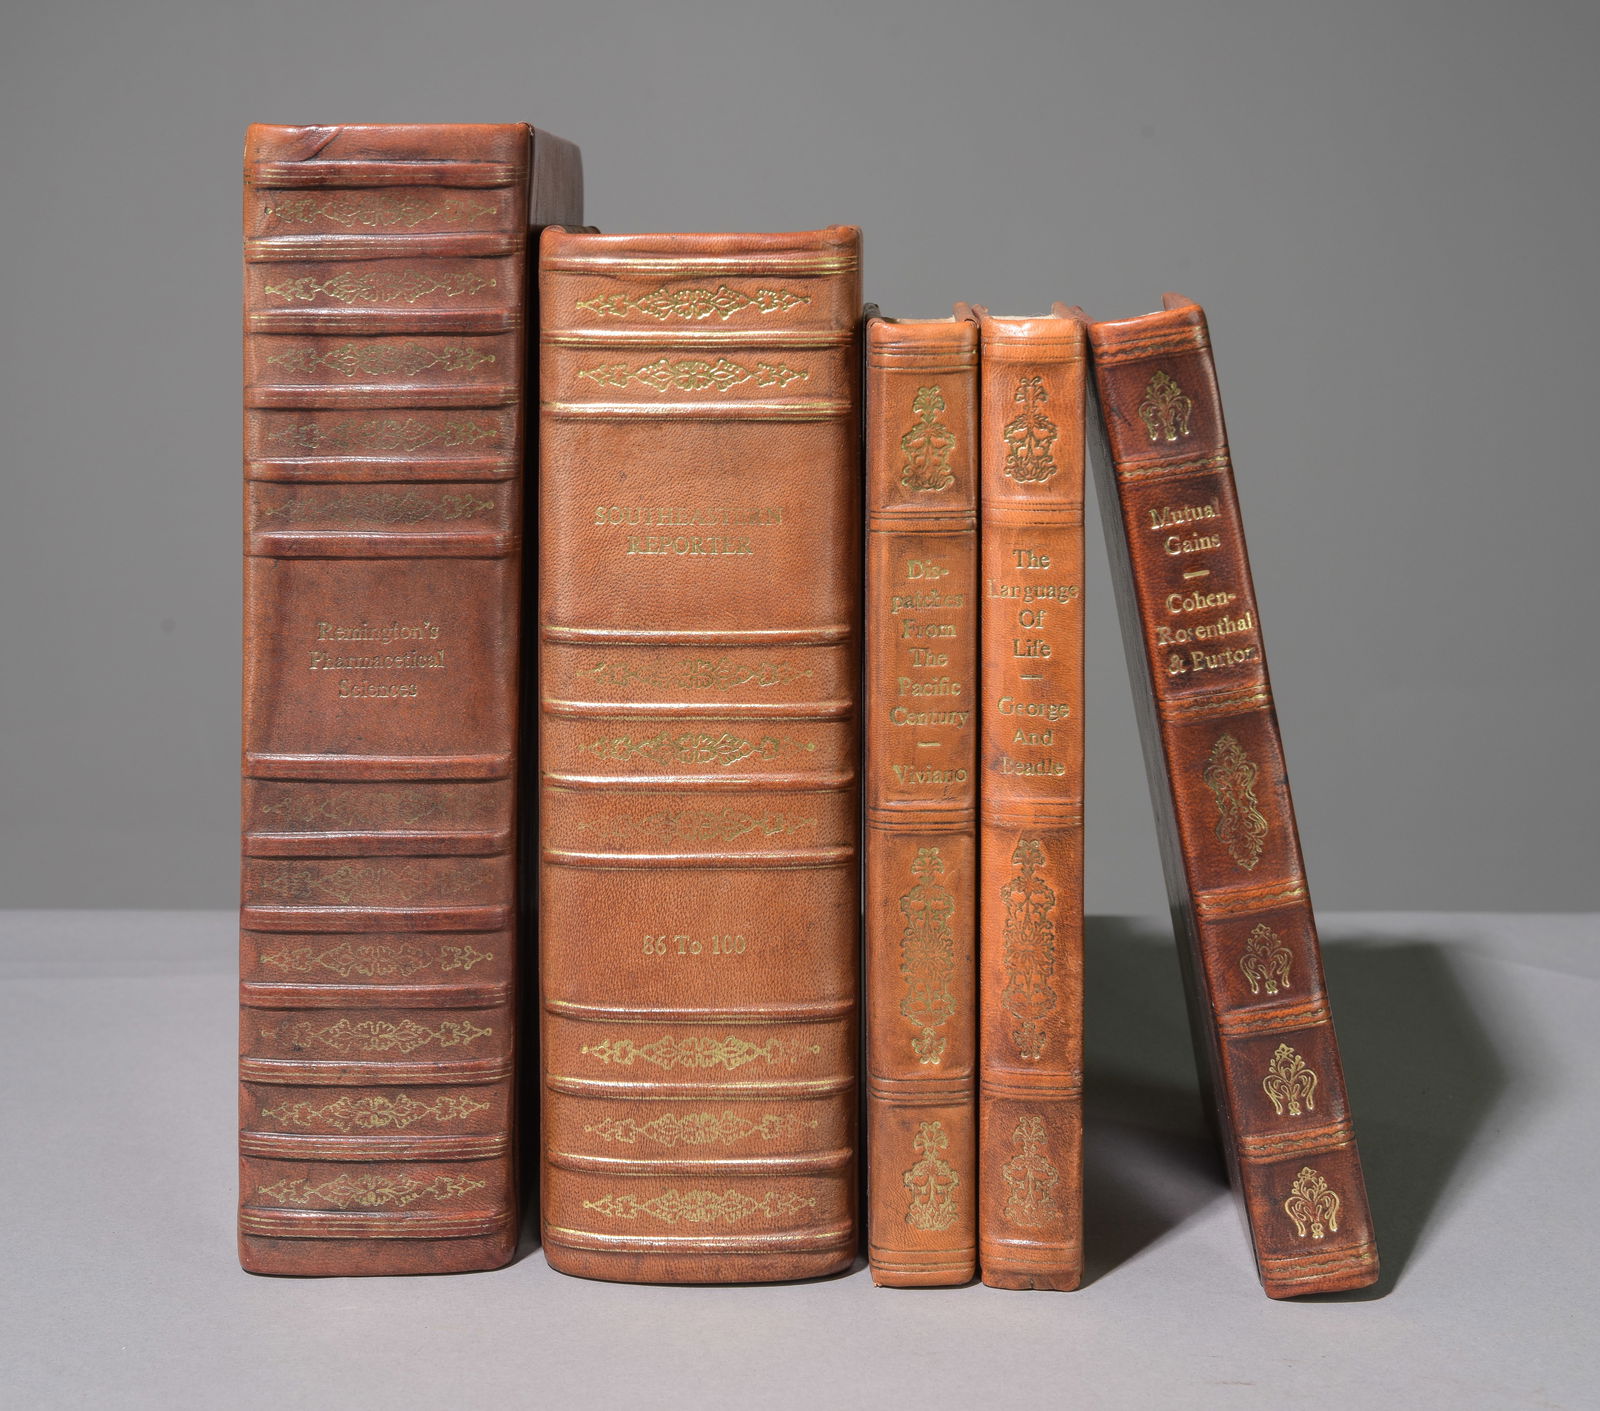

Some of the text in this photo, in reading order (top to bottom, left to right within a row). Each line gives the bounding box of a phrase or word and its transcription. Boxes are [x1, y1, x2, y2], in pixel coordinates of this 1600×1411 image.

[594, 505, 785, 526] SOUTHEASTERN
[1149, 496, 1221, 530] Mutual
[627, 536, 754, 555] REPORTER
[1164, 532, 1221, 555] Gains
[906, 560, 949, 580] Dis-
[1012, 549, 1051, 570] The
[987, 578, 1080, 604] Language
[1166, 590, 1237, 614] Cohen-
[902, 619, 957, 638] From
[1019, 609, 1046, 629] Of
[1156, 611, 1255, 646] Rosenthal
[317, 620, 440, 644] Remington's
[909, 646, 949, 667] The
[1012, 638, 1052, 659] Life
[1169, 654, 1186, 675] &
[338, 679, 418, 698] Sciences
[898, 676, 961, 696] Pacific
[889, 706, 969, 728] Century
[998, 696, 1070, 722] George
[1013, 728, 1055, 746] And
[892, 764, 968, 785] Viviano
[1000, 756, 1066, 776] Beadle
[642, 935, 747, 955] 86 To 100
